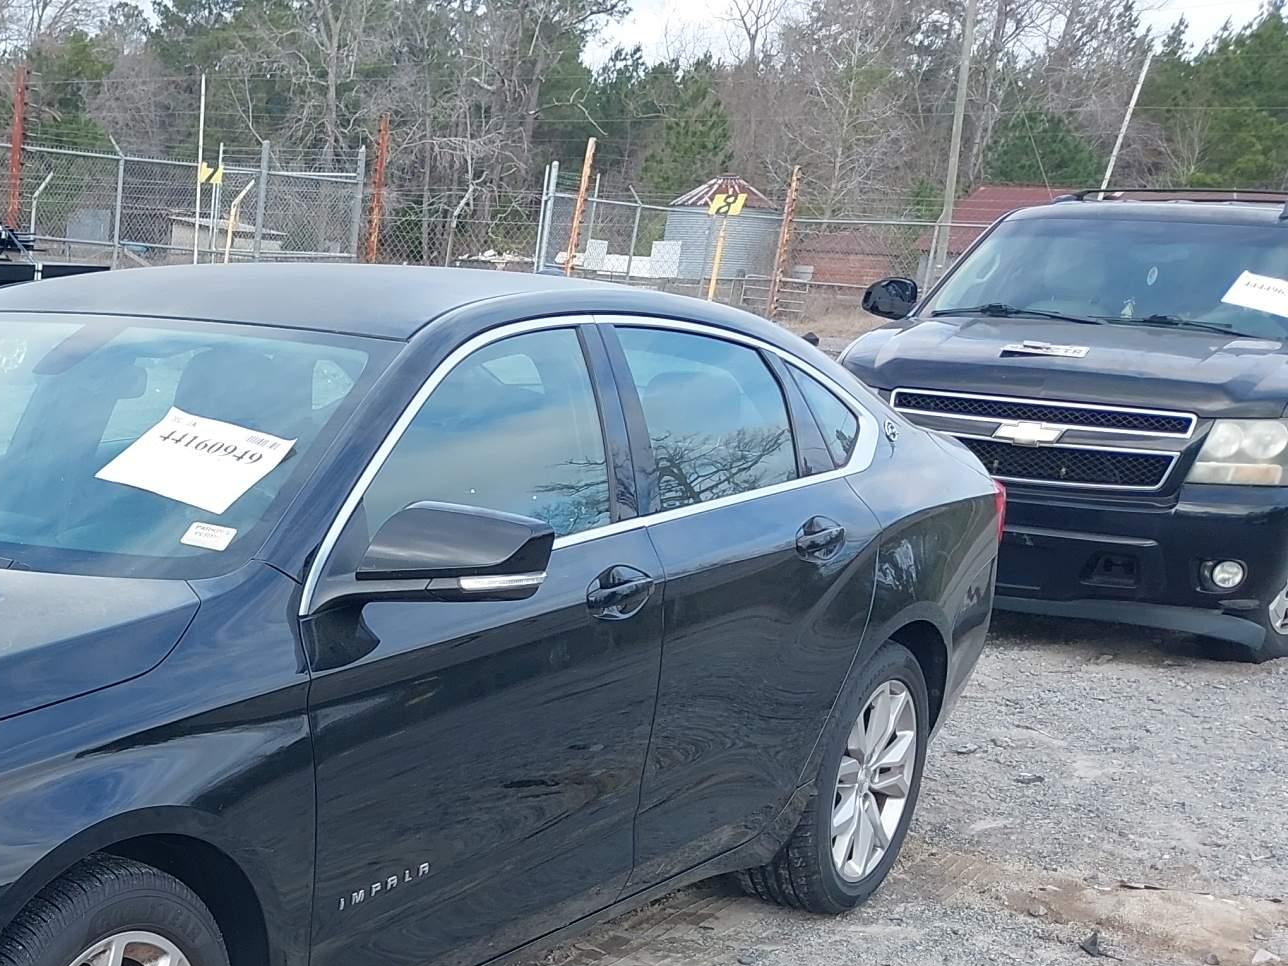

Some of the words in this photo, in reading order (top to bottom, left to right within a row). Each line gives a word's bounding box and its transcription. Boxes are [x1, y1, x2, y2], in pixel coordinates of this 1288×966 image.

[715, 193, 735, 214] 8
[159, 429, 264, 465] 44160949
[337, 862, 431, 911] IMPALA
